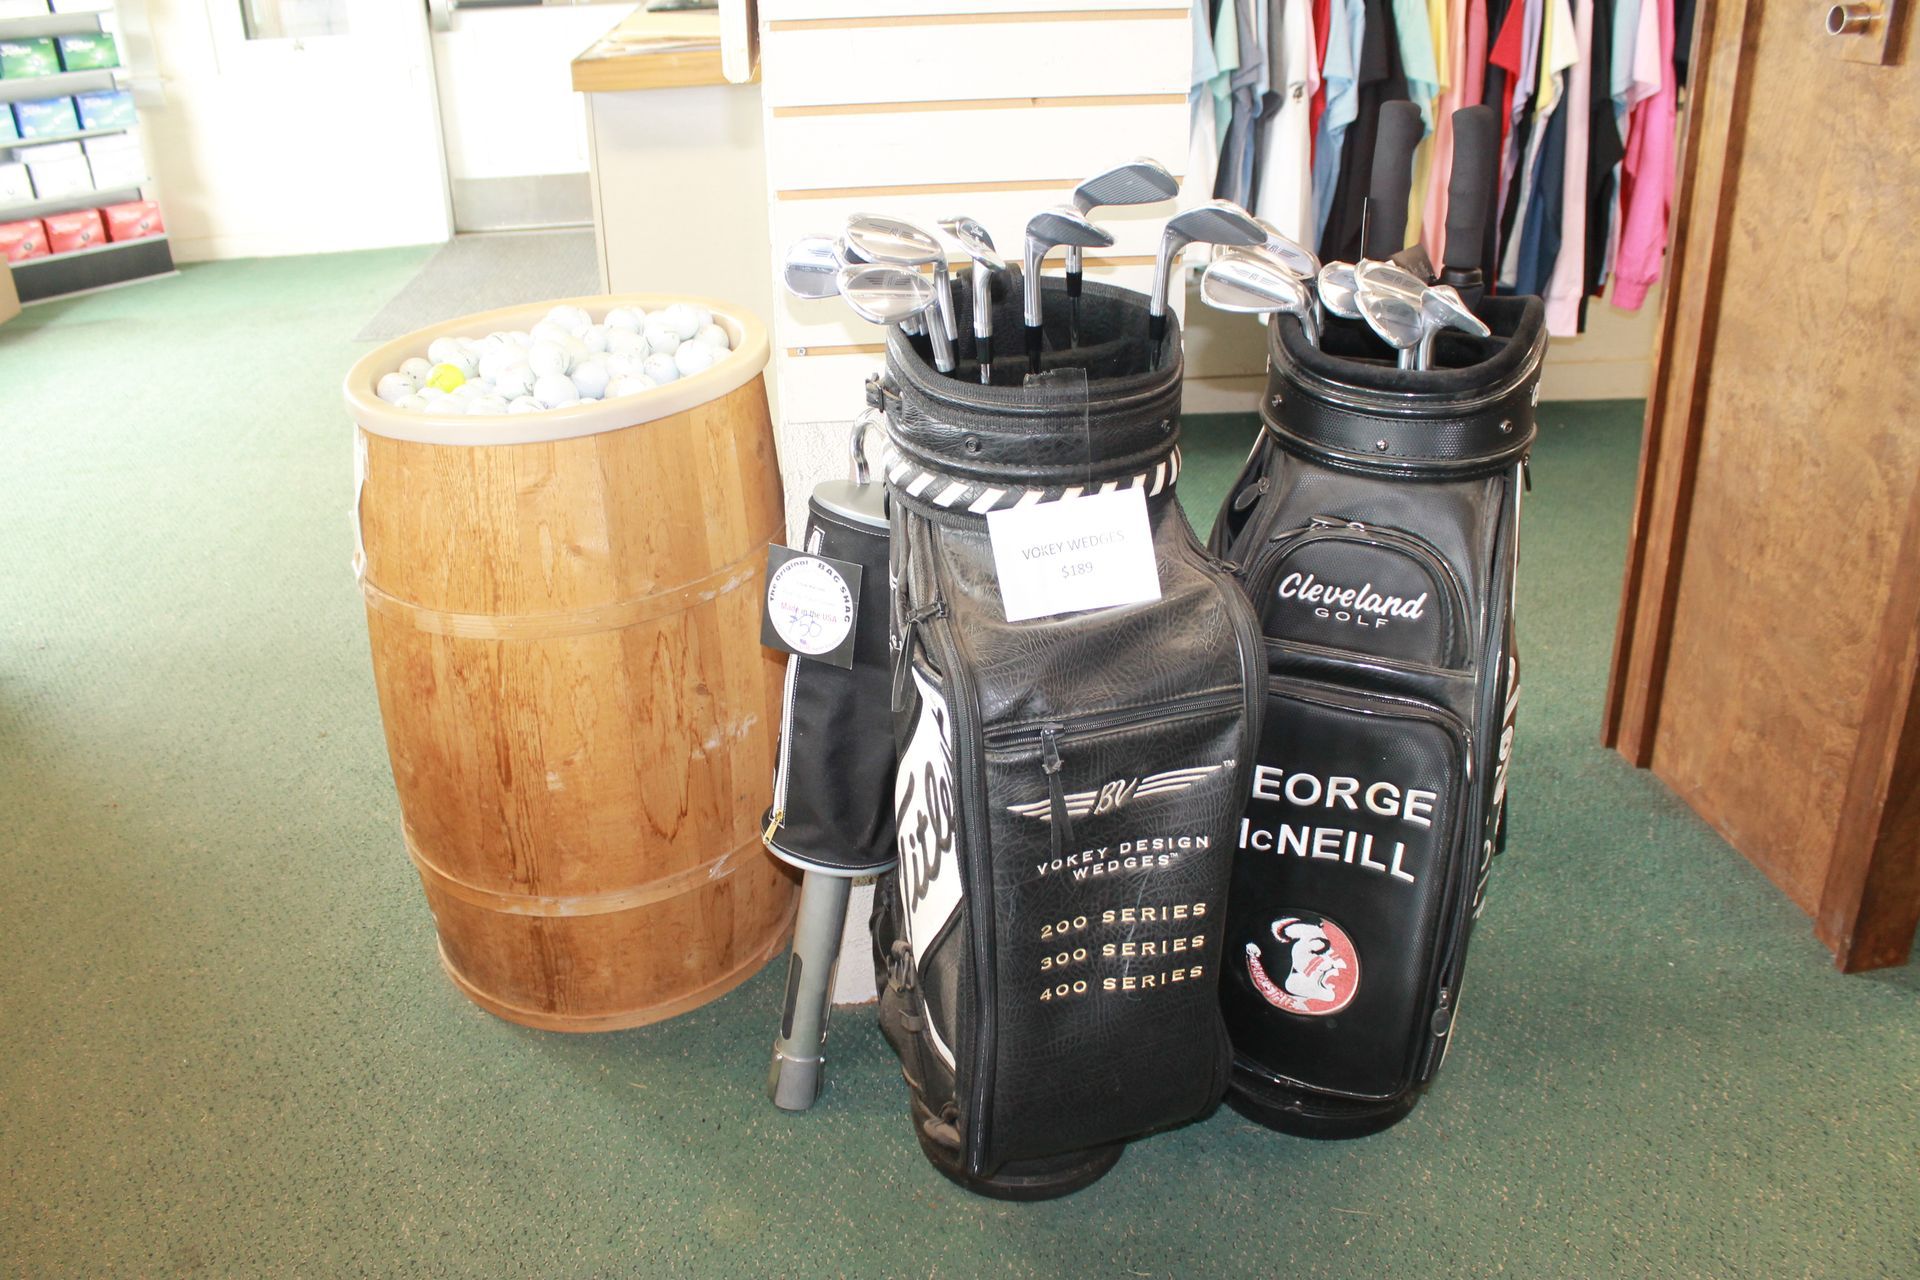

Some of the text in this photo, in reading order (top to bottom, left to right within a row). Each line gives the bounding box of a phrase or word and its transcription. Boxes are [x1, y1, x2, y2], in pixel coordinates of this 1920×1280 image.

[1022, 530, 1125, 560] VOKEY WEDGES
[1061, 561, 1093, 578] $189
[1278, 572, 1428, 620] Cleveland
[1315, 607, 1389, 628] GOLF
[1252, 764, 1437, 828] EORGE
[1037, 836, 1209, 875] VOKEY DESIGN
[1041, 903, 1206, 939] 200 SERIES
[1041, 935, 1205, 970] 300 SERIES
[1040, 966, 1203, 1001] 400 SERIES
